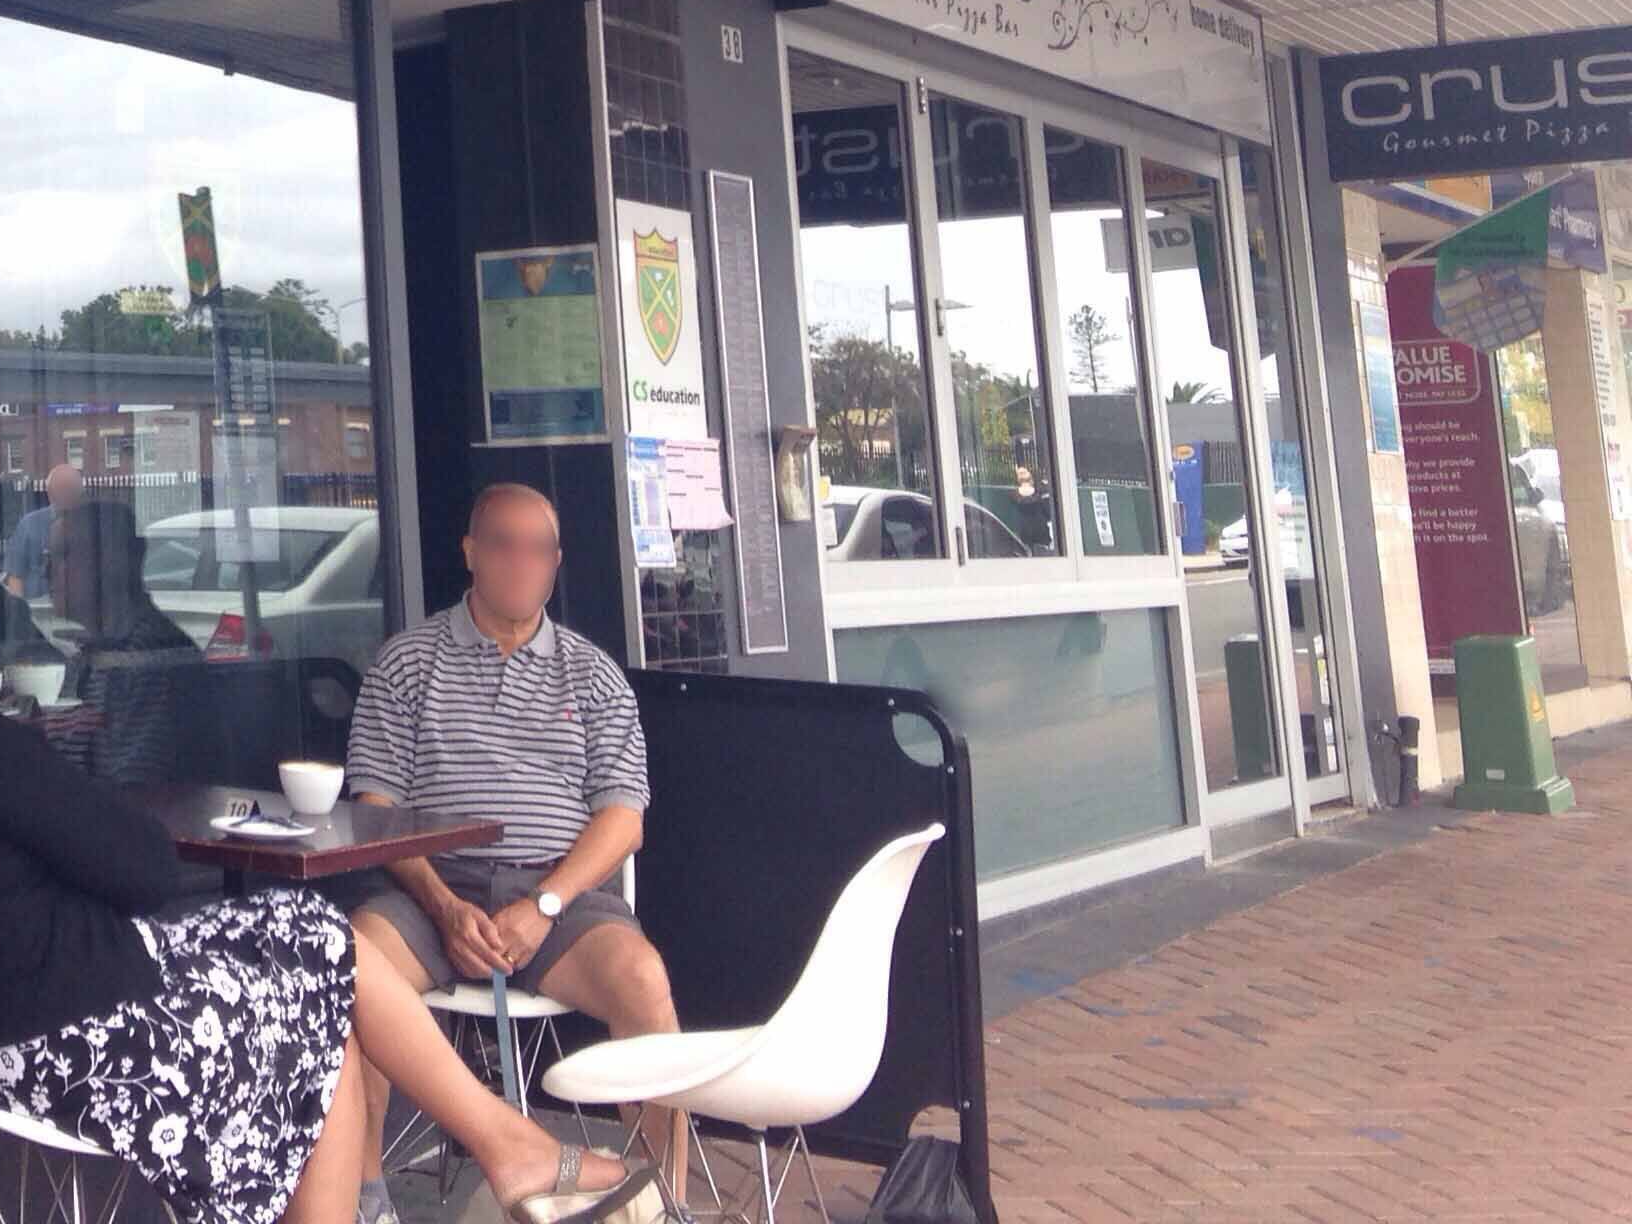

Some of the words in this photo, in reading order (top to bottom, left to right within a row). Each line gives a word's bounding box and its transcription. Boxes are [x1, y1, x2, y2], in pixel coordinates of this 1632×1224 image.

[995, 3, 1019, 37] Bar
[1383, 127, 1506, 154] Gourmet
[1526, 118, 1609, 146] Pizza
[1394, 345, 1452, 366] ALUE
[1397, 364, 1467, 386] OMISE
[632, 380, 648, 402] CS
[650, 385, 701, 407] education
